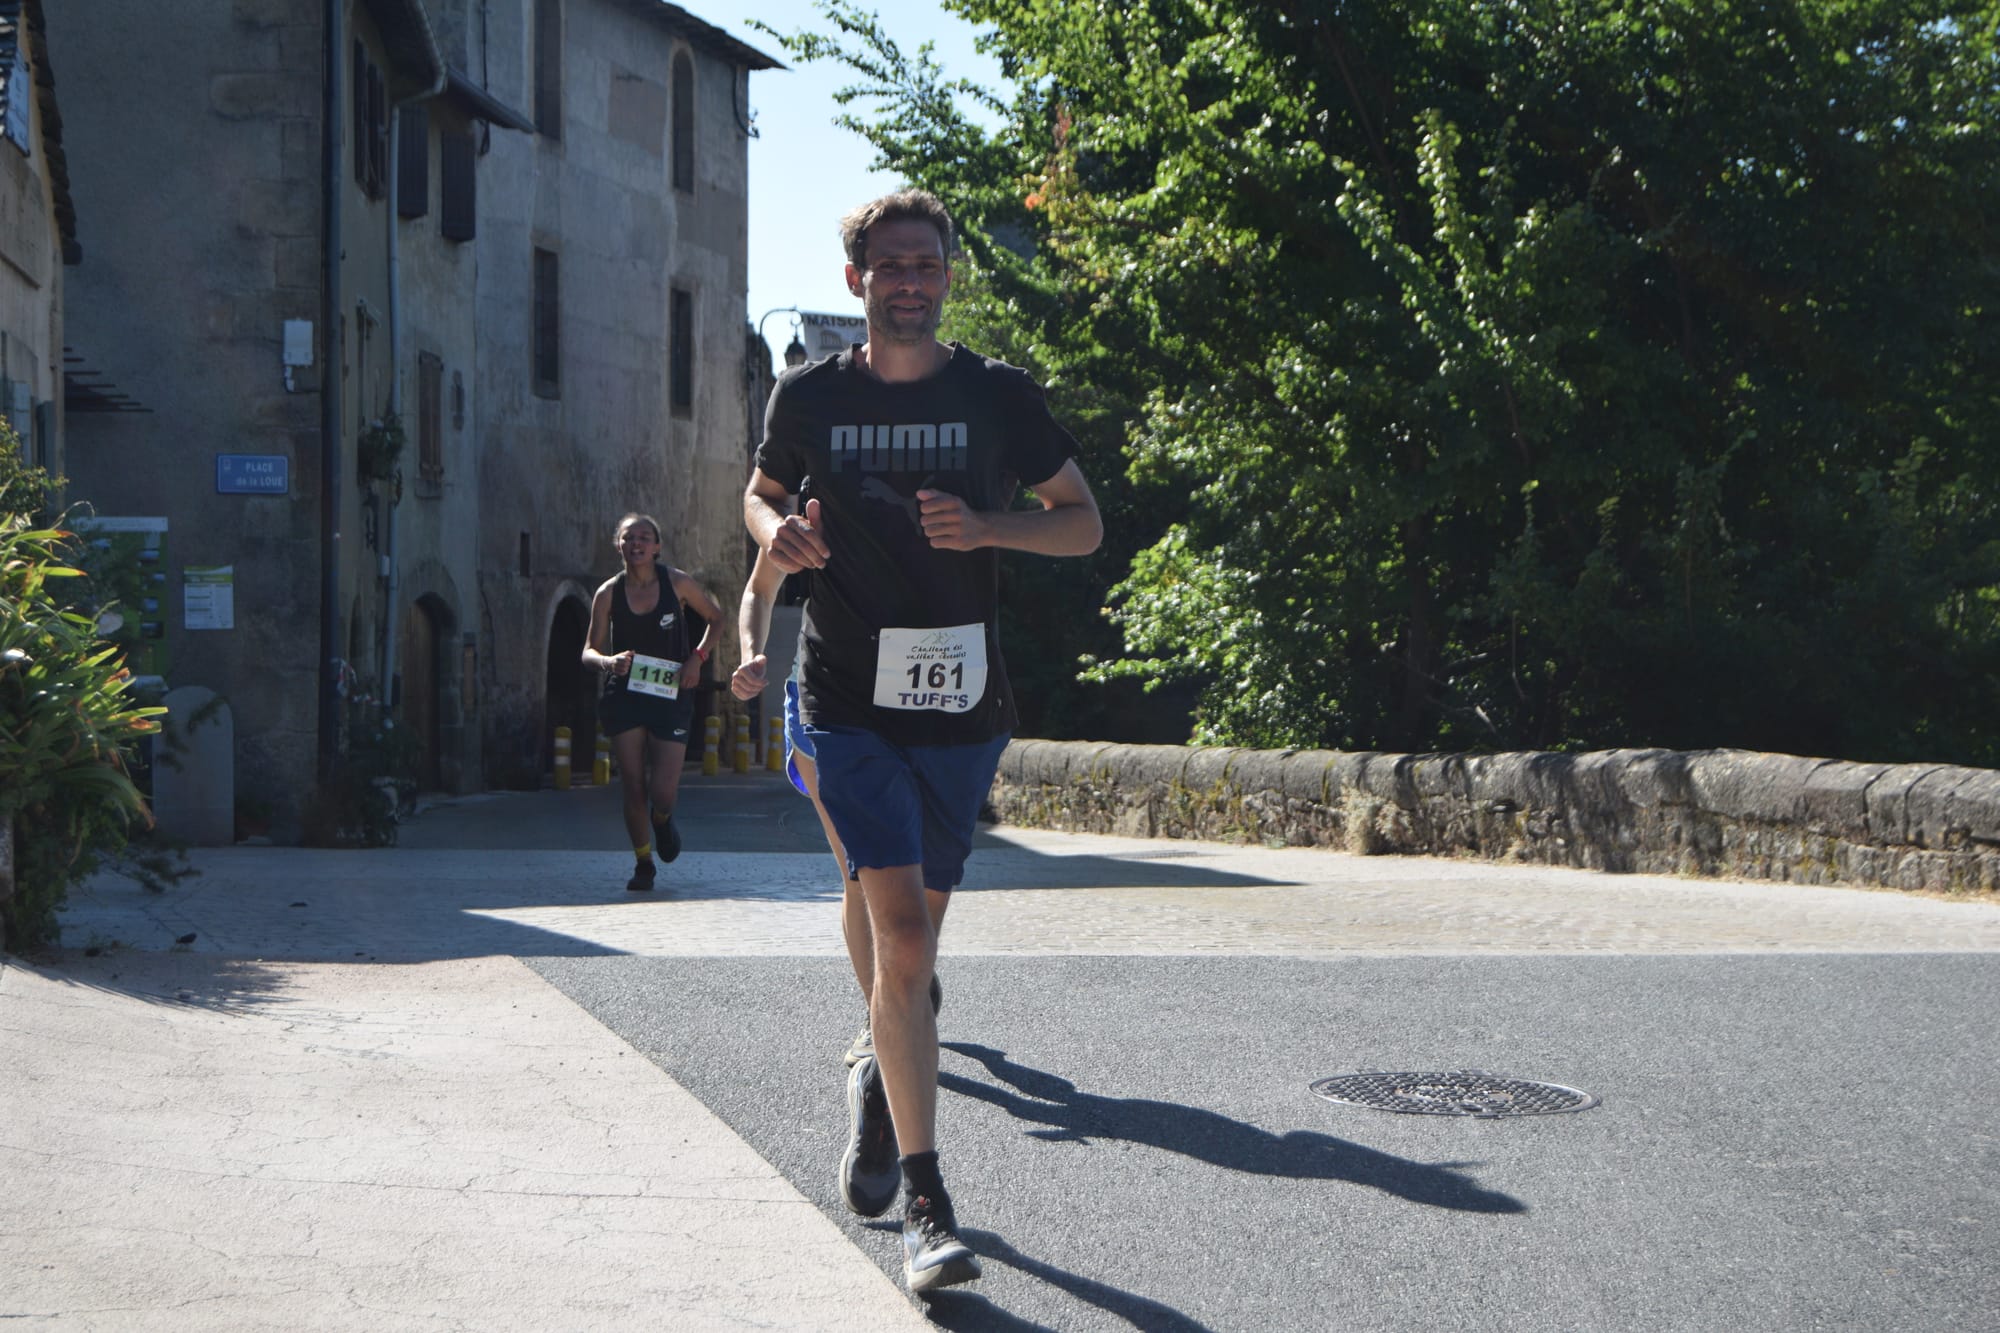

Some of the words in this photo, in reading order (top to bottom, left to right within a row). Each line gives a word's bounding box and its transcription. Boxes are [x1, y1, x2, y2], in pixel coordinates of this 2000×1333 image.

[831, 422, 967, 473] PUMA
[245, 461, 273, 472] PLACE
[911, 645, 950, 654] Challenge
[639, 665, 674, 685] 118
[906, 661, 964, 690] 161
[898, 692, 969, 708] TUFF'S
